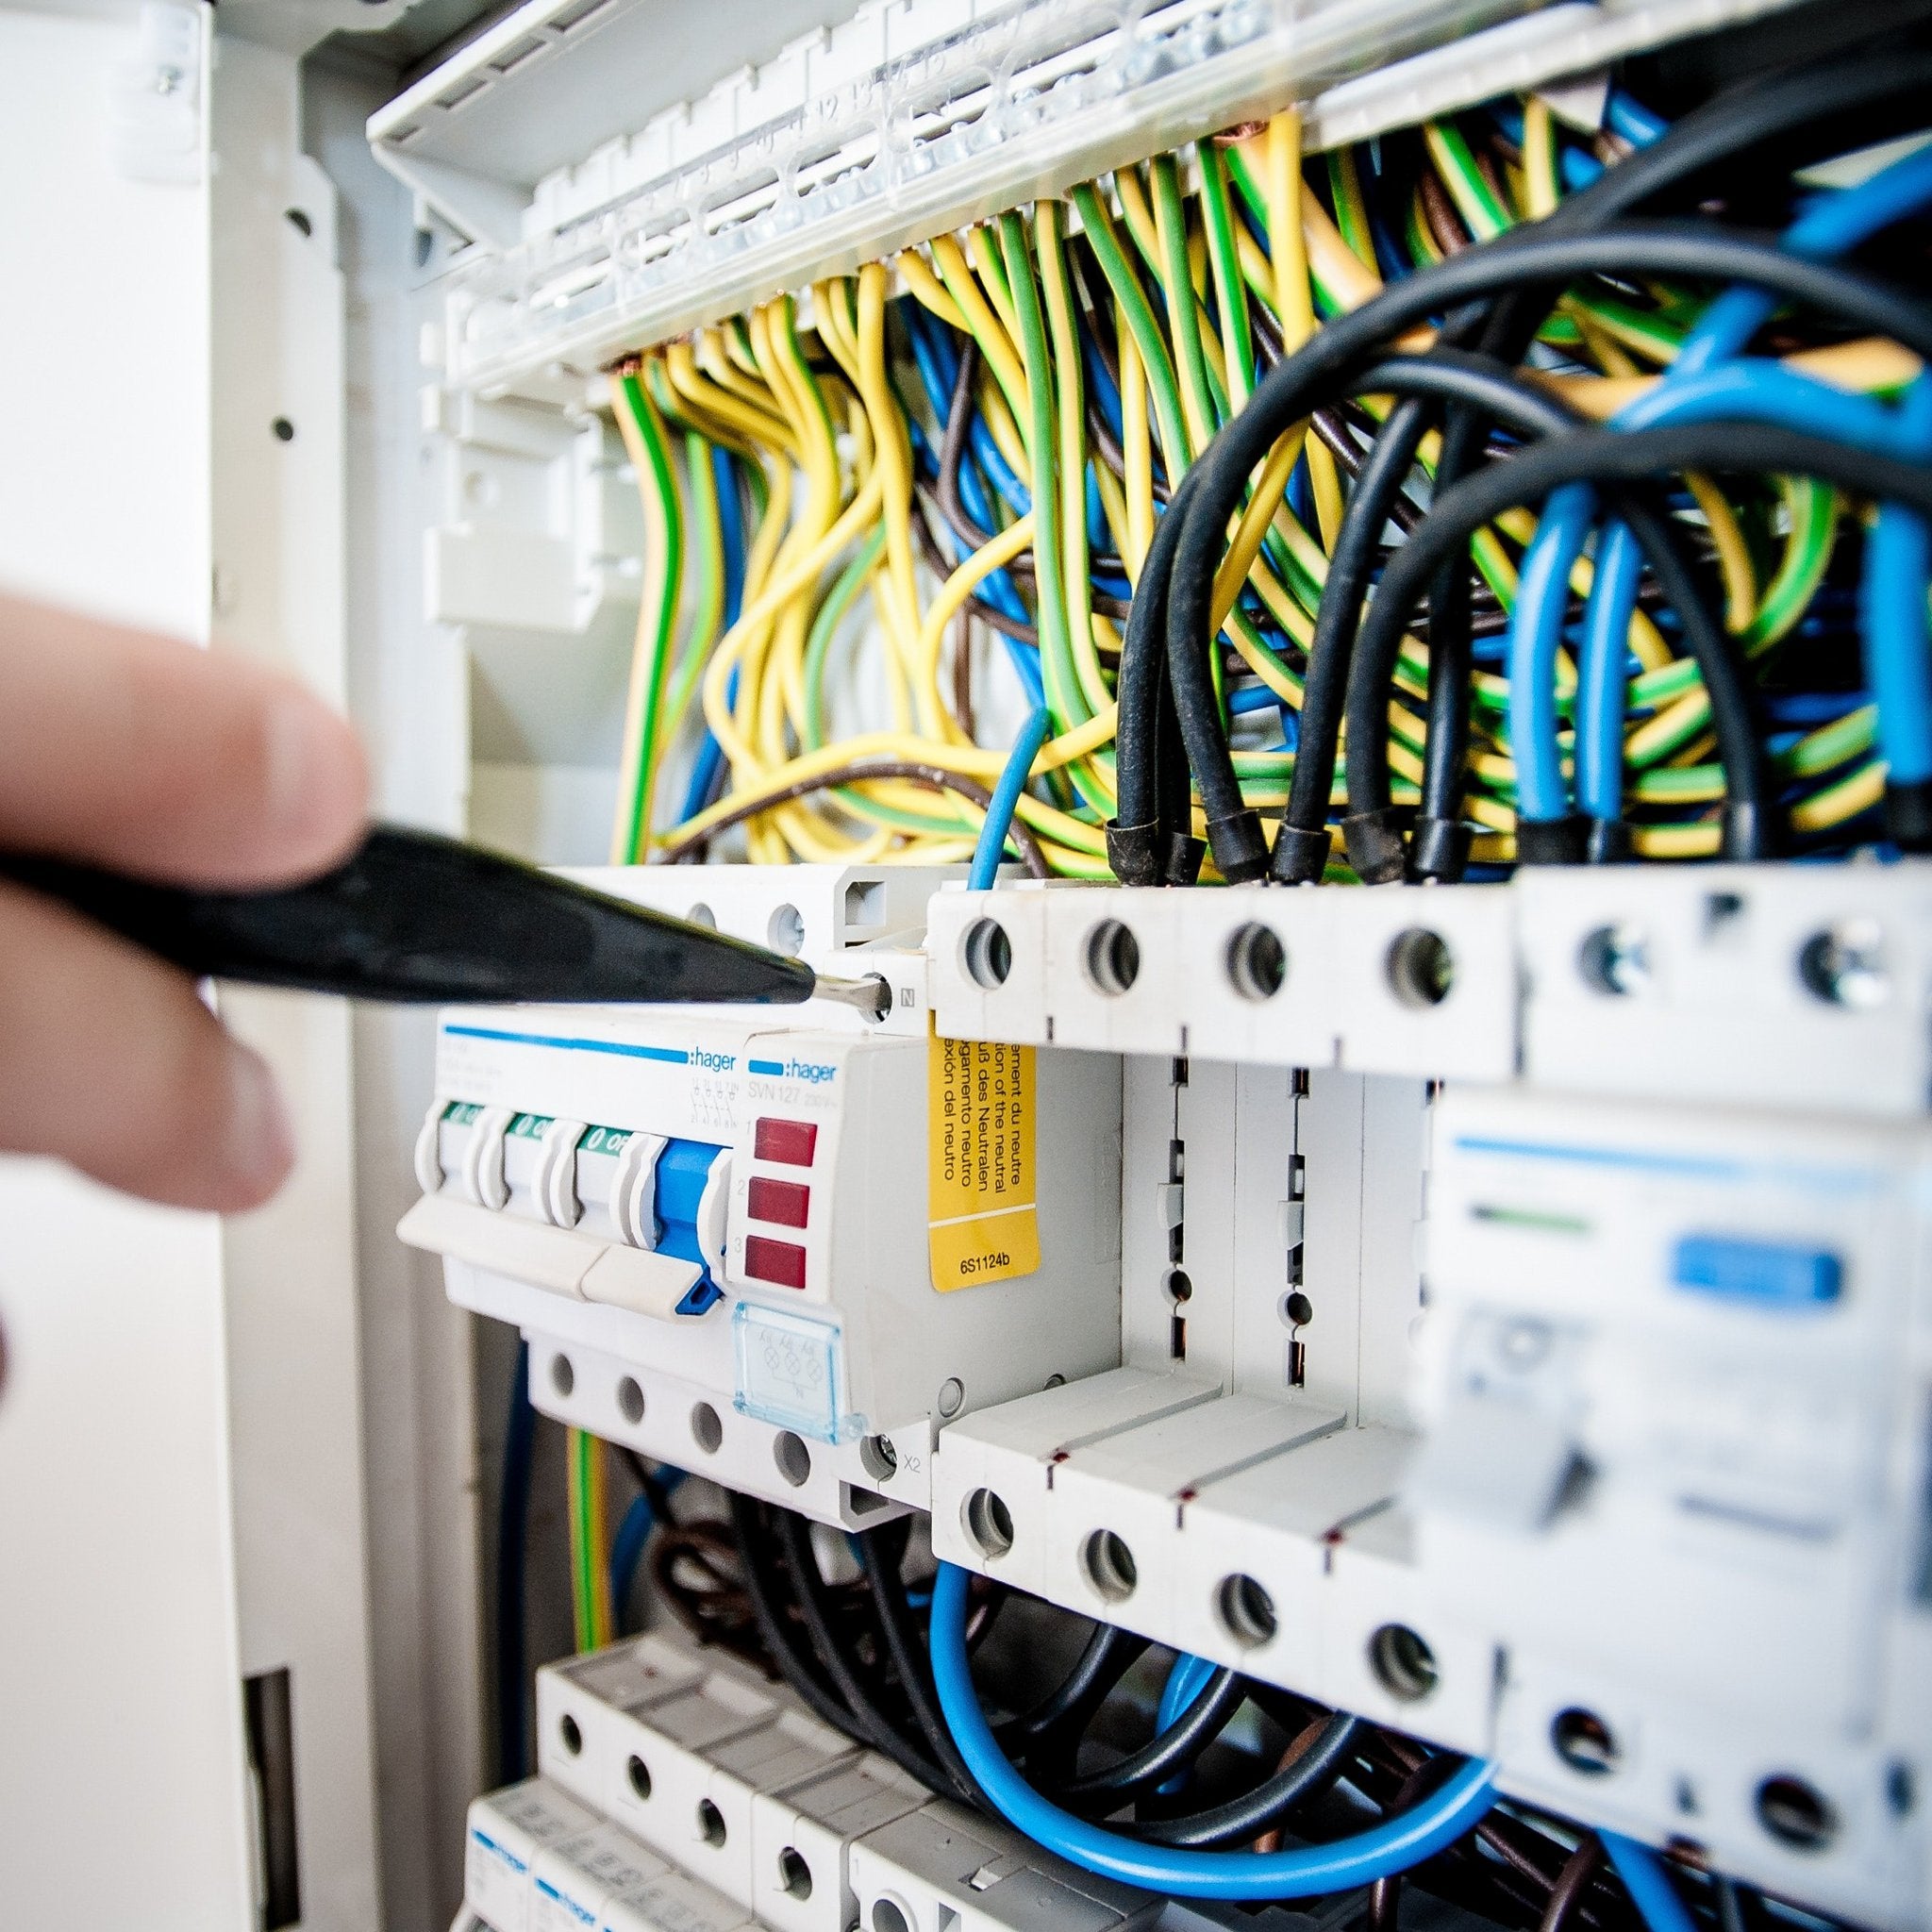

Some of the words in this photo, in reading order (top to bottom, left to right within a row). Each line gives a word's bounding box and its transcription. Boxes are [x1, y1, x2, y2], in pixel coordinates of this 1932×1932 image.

[902, 990, 914, 1007] N
[944, 1038, 957, 1084] exión
[1011, 1043, 1022, 1097] ement
[748, 1080, 774, 1101] SVN
[779, 1085, 800, 1104] 127
[978, 1069, 990, 1102] des
[994, 1079, 1006, 1097] of
[943, 1090, 957, 1117] del
[995, 1101, 1006, 1129] the
[1010, 1102, 1022, 1124] du
[587, 1127, 607, 1149] 0
[944, 1123, 956, 1180] neutro
[978, 1107, 990, 1191] Neutralen
[961, 1130, 973, 1187] neutro
[994, 1135, 1006, 1193] neutral
[1010, 1130, 1022, 1185] neutre
[737, 1179, 745, 1196] 2
[734, 1237, 742, 1254] 3
[959, 1251, 1010, 1274] 6S1124b
[904, 1454, 921, 1474] X2
